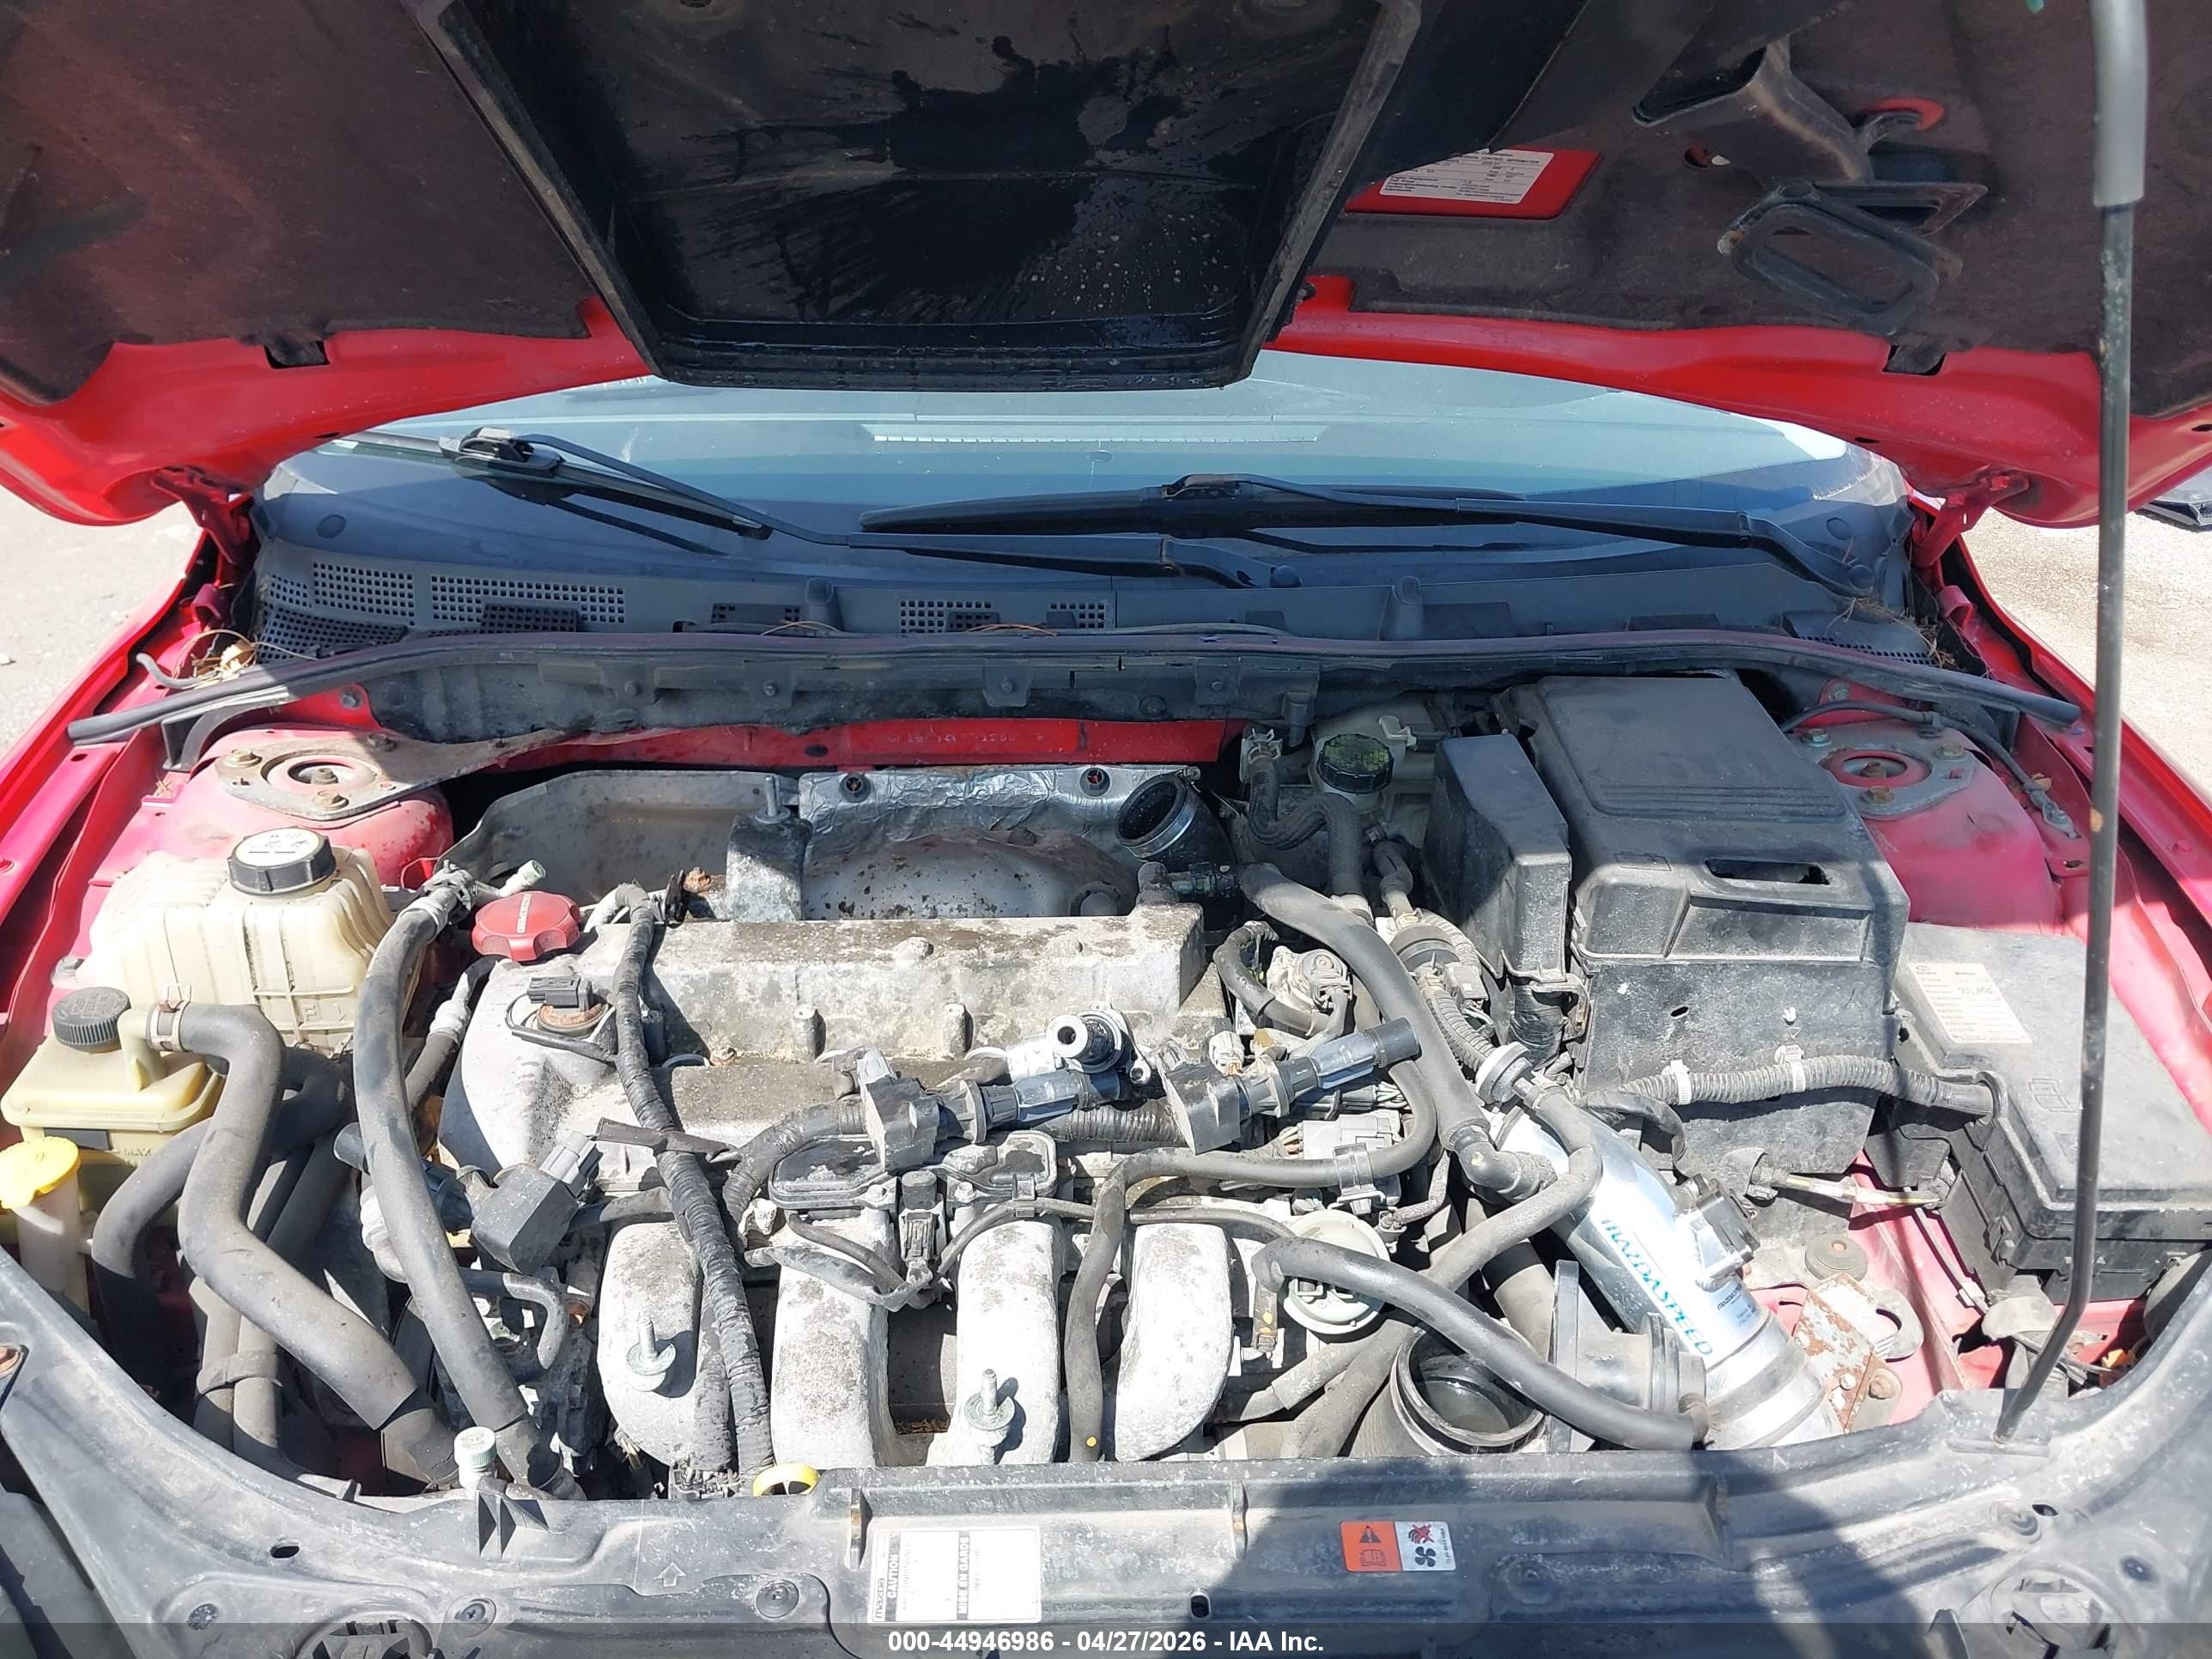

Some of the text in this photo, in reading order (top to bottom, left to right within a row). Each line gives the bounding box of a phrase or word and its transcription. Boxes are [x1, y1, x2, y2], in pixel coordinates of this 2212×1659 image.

[1600, 1219, 1714, 1356] MAZDASPEED
[887, 1553, 900, 1598] CAUTION
[958, 1573, 969, 1587] EN
[957, 1589, 969, 1614] MISE
